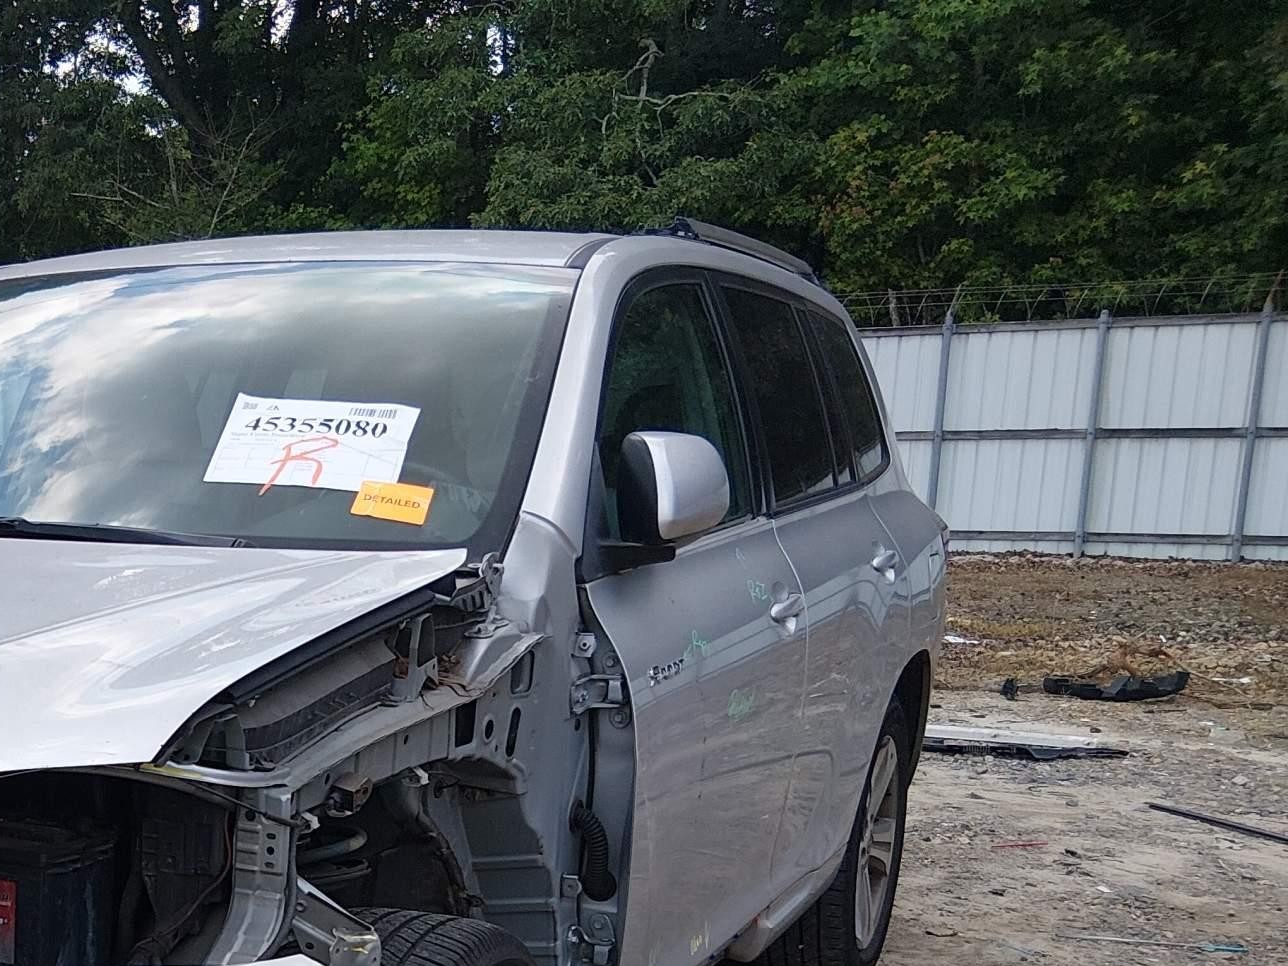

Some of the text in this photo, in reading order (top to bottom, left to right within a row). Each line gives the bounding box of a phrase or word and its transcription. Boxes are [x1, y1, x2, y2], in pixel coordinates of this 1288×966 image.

[244, 416, 388, 438] 45355080
[258, 436, 339, 496] R
[363, 494, 421, 510] DETAILED
